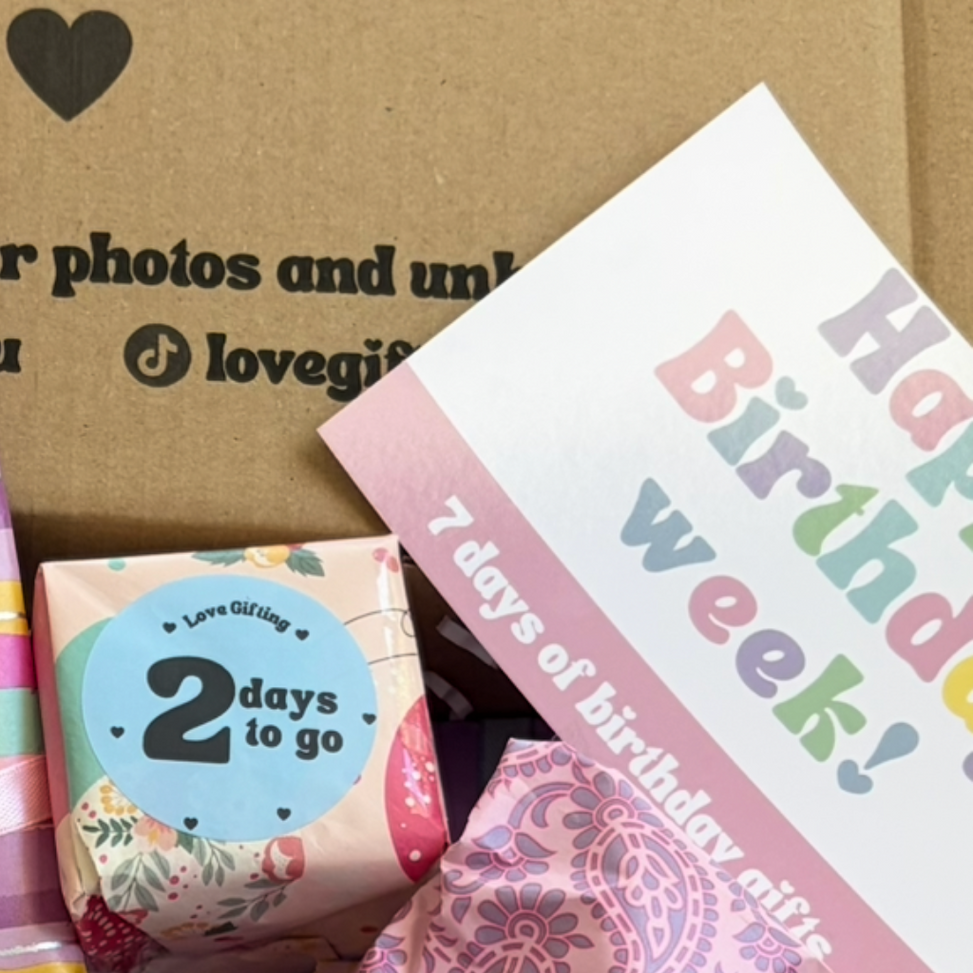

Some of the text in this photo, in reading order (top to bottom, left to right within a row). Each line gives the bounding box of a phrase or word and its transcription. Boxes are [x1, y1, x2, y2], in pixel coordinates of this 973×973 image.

[51, 232, 262, 297] photos
[277, 245, 396, 296] and
[207, 333, 421, 402] lovegif
[182, 600, 291, 633] Love Gifting
[620, 477, 919, 795] week!
[142, 655, 339, 764] 2 days
[428, 494, 475, 536] 7
[453, 540, 545, 645] days
[537, 643, 597, 692] of
[575, 681, 744, 863] birthday
[245, 718, 344, 761] to go
